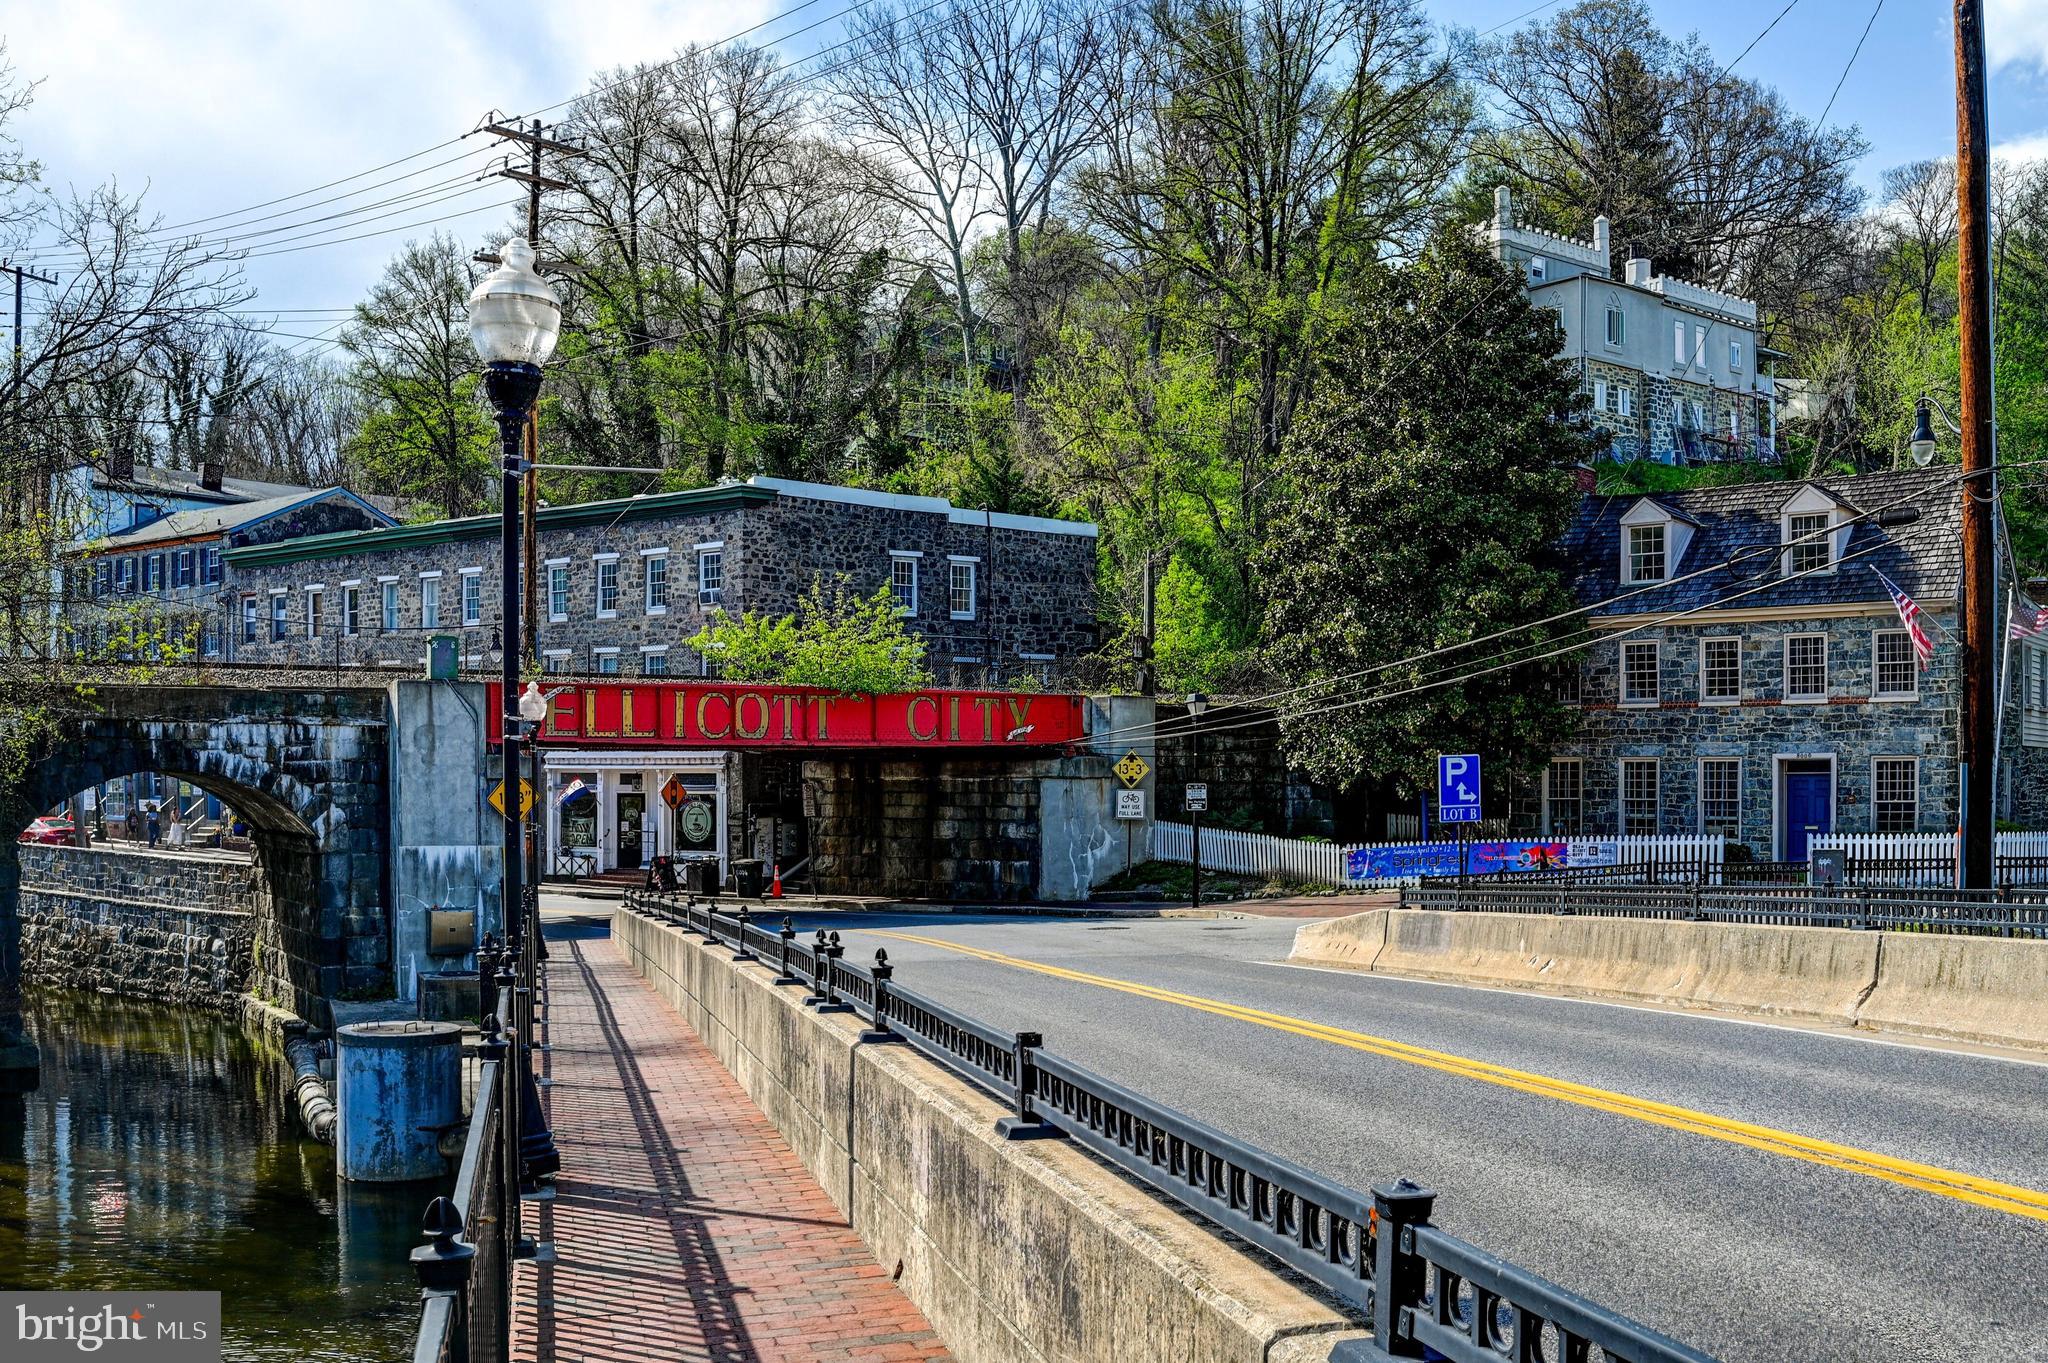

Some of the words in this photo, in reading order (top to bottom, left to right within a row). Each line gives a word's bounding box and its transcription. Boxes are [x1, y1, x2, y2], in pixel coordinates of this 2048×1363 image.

[544, 686, 837, 741] ELLICOTT
[905, 696, 1034, 741] CITY
[1446, 757, 1468, 786] P
[1443, 808, 1465, 820] LOT
[1470, 808, 1477, 819] B
